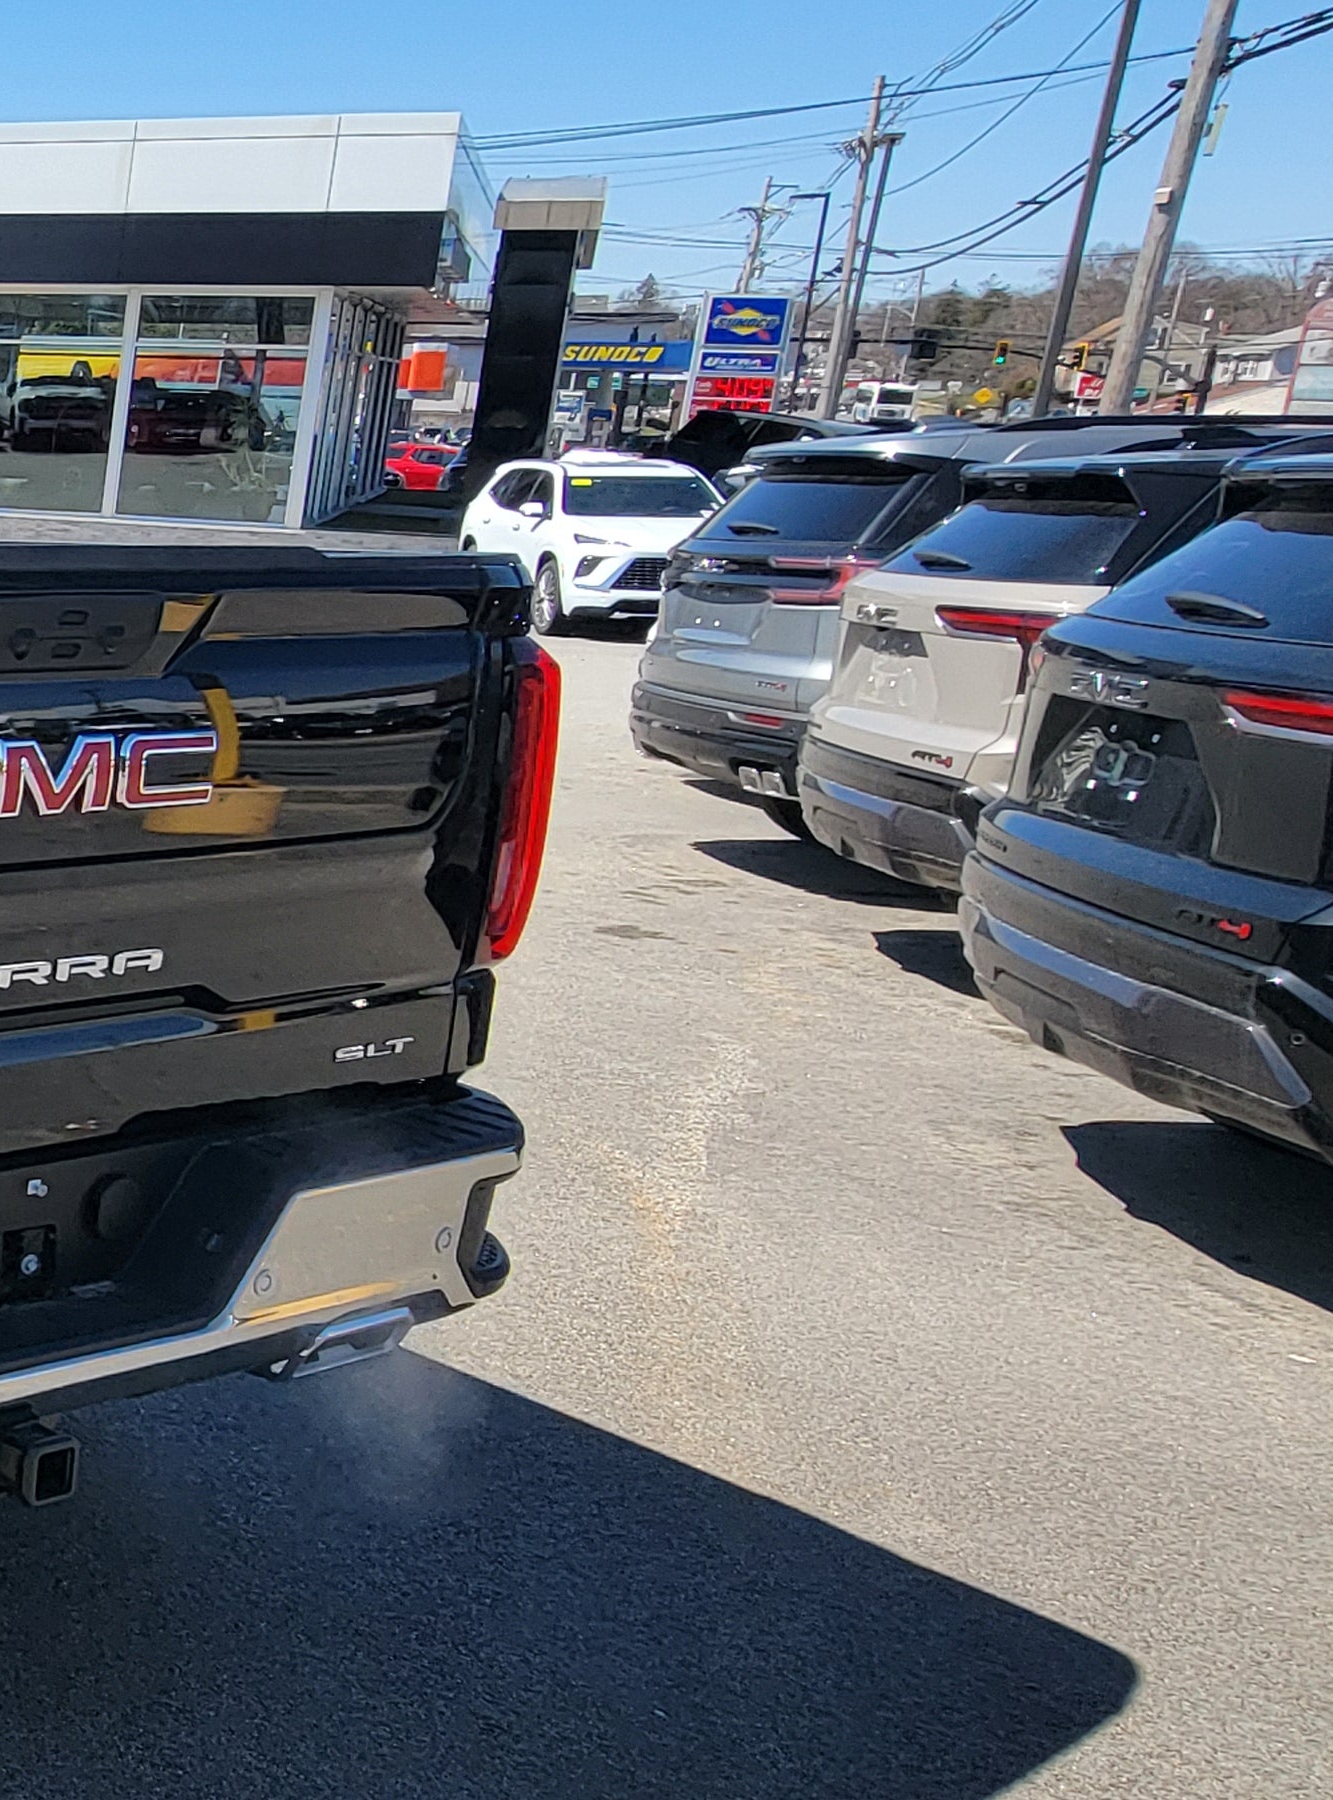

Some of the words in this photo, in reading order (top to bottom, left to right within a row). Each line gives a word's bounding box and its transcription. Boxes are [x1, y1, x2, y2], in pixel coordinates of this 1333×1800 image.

[713, 315, 780, 330] SUNOCO
[562, 344, 665, 362] SUNOCO
[911, 750, 954, 769] AT4
[334, 1037, 415, 1063] SLT
